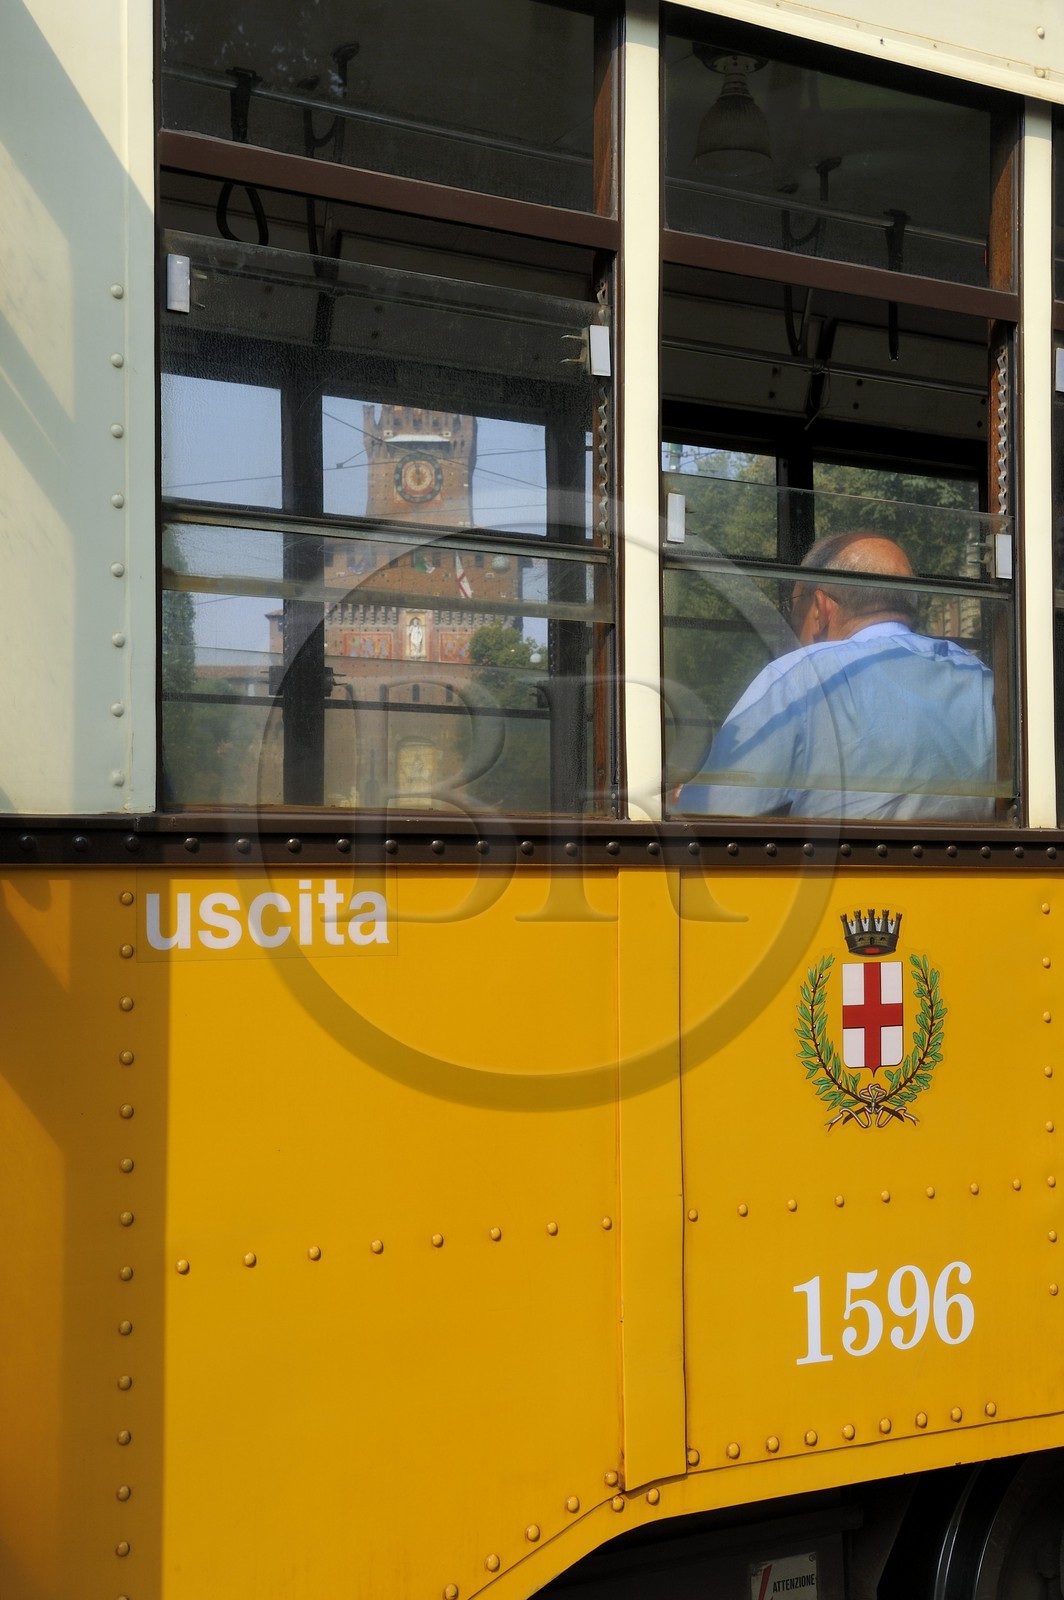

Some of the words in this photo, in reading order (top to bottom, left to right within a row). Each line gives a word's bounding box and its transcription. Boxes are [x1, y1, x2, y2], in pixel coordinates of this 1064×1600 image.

[145, 879, 390, 950] uscita
[793, 1261, 975, 1365] 1596
[772, 1573, 816, 1593] ATTENZIONE
